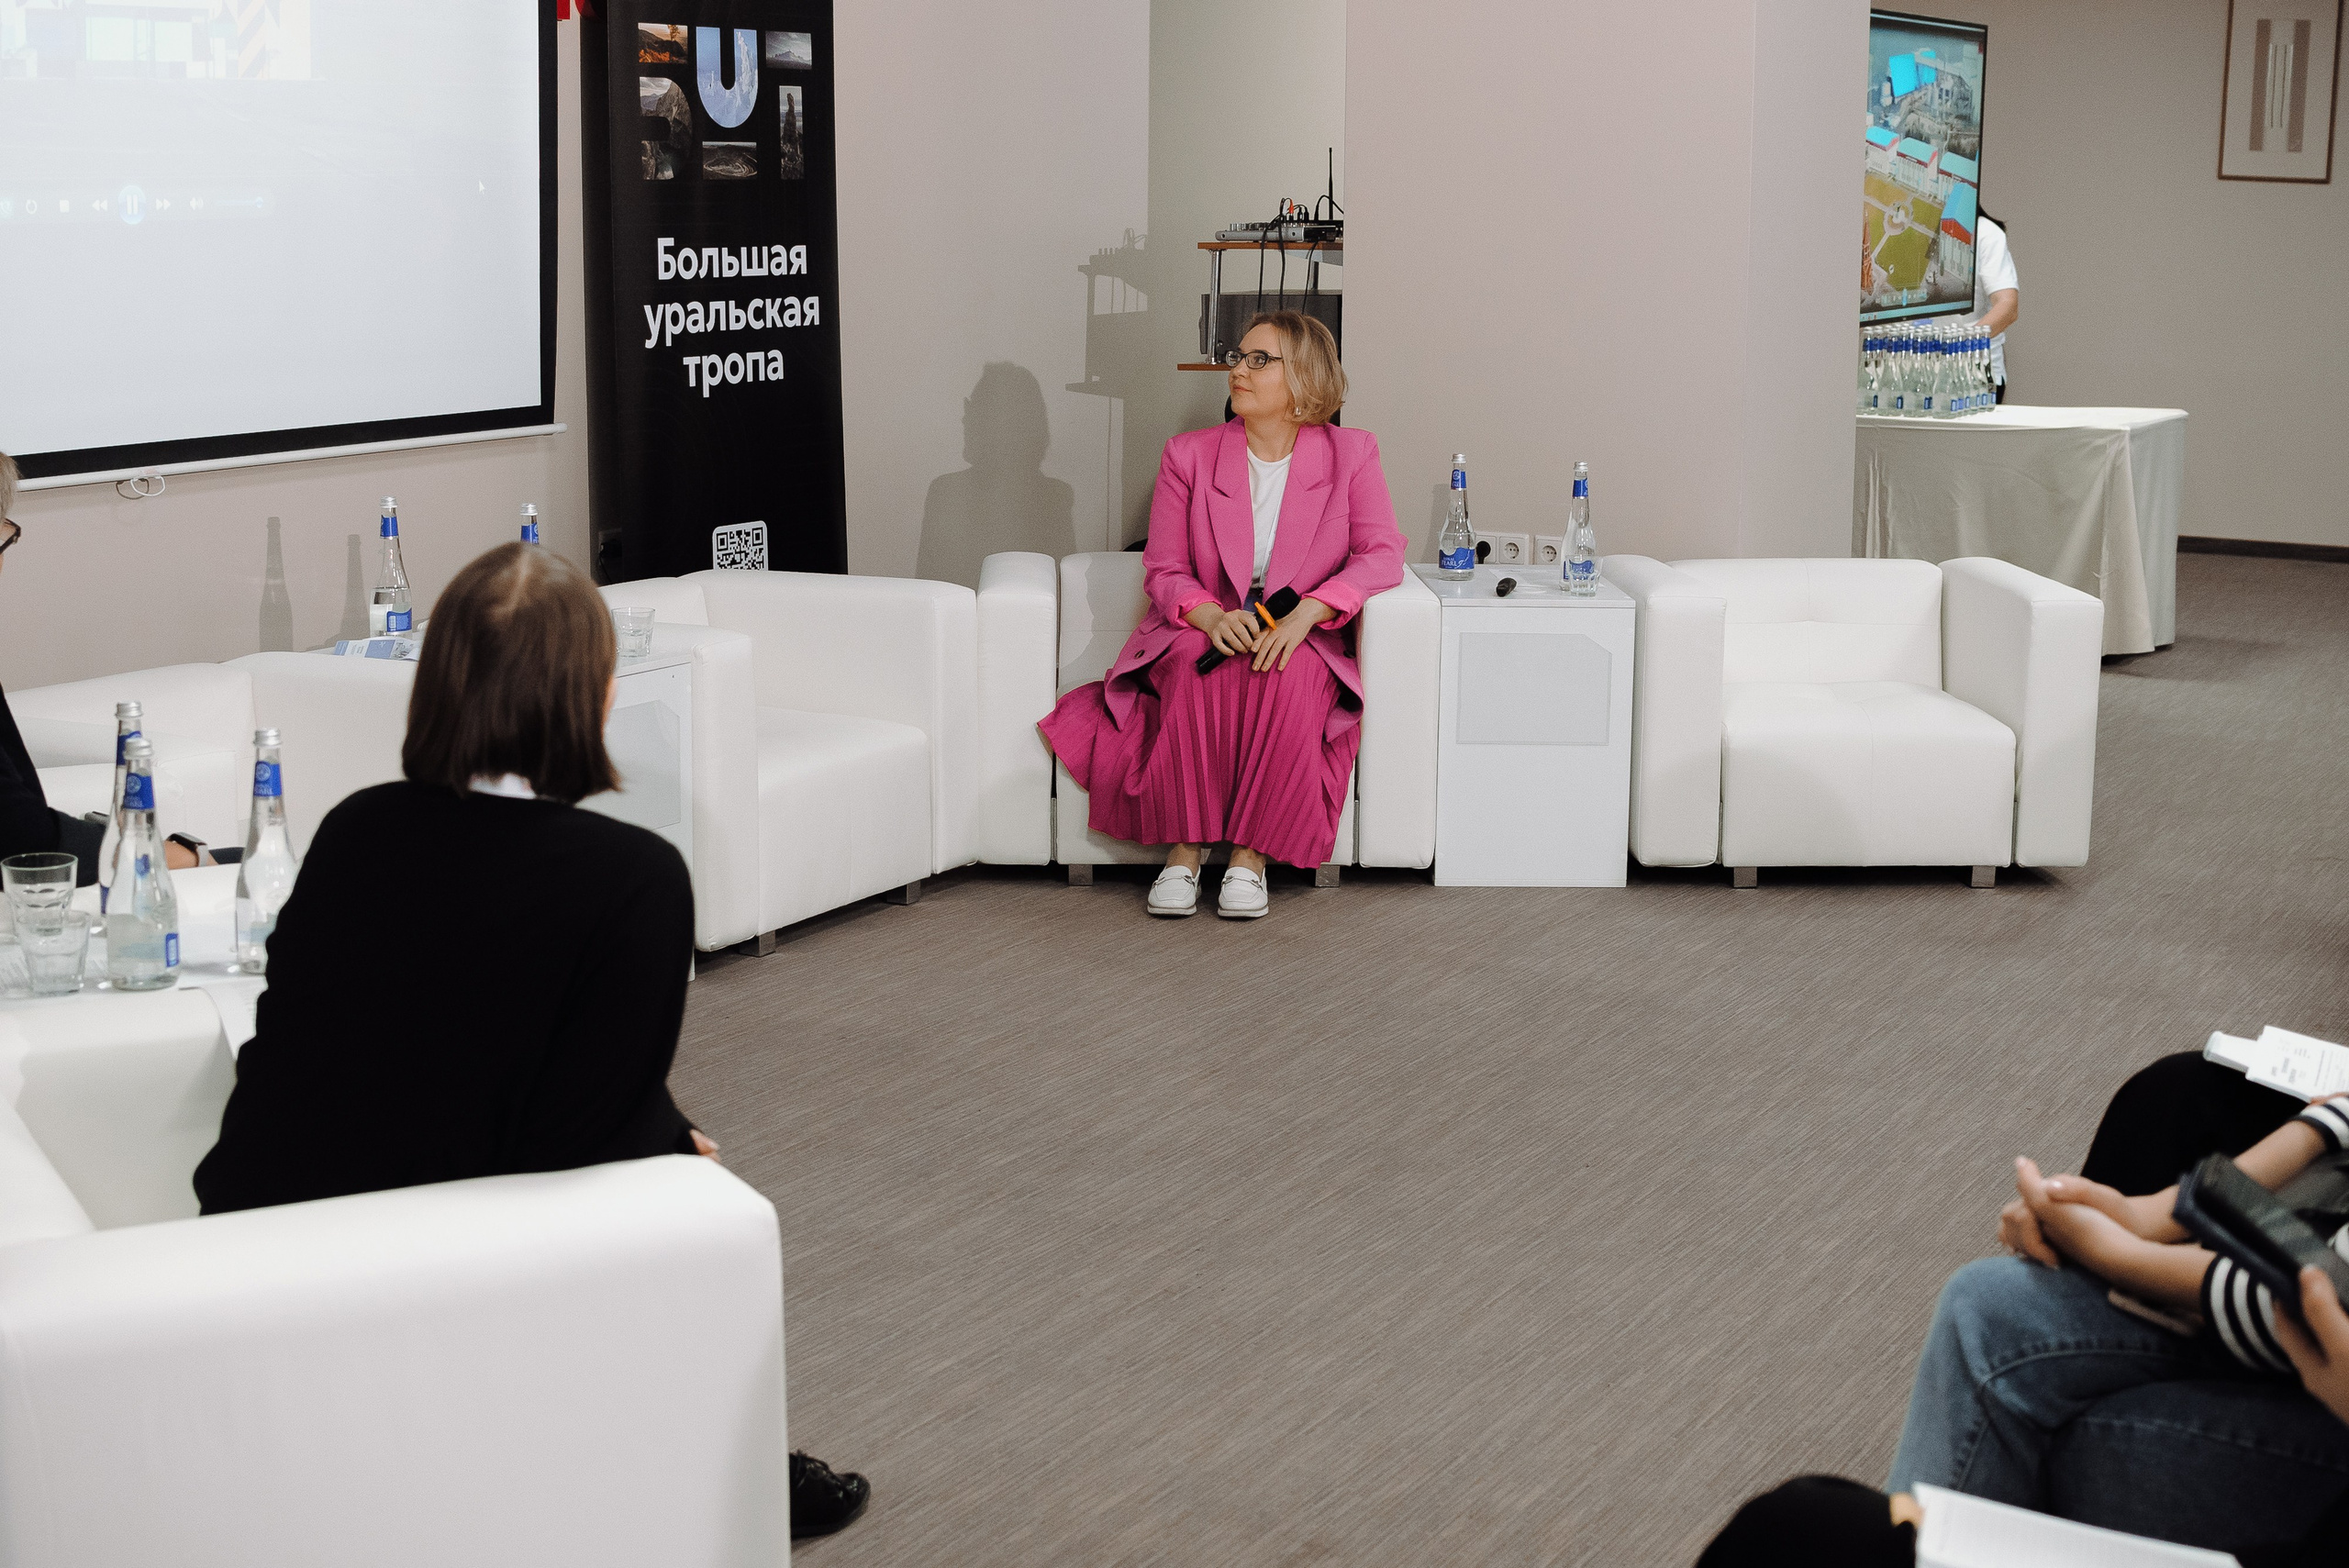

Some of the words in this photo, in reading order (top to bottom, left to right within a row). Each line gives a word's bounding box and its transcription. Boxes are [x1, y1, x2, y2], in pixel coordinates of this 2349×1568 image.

[657, 237, 807, 281] Большая
[643, 295, 820, 350] уральская
[683, 349, 785, 398] тропа
